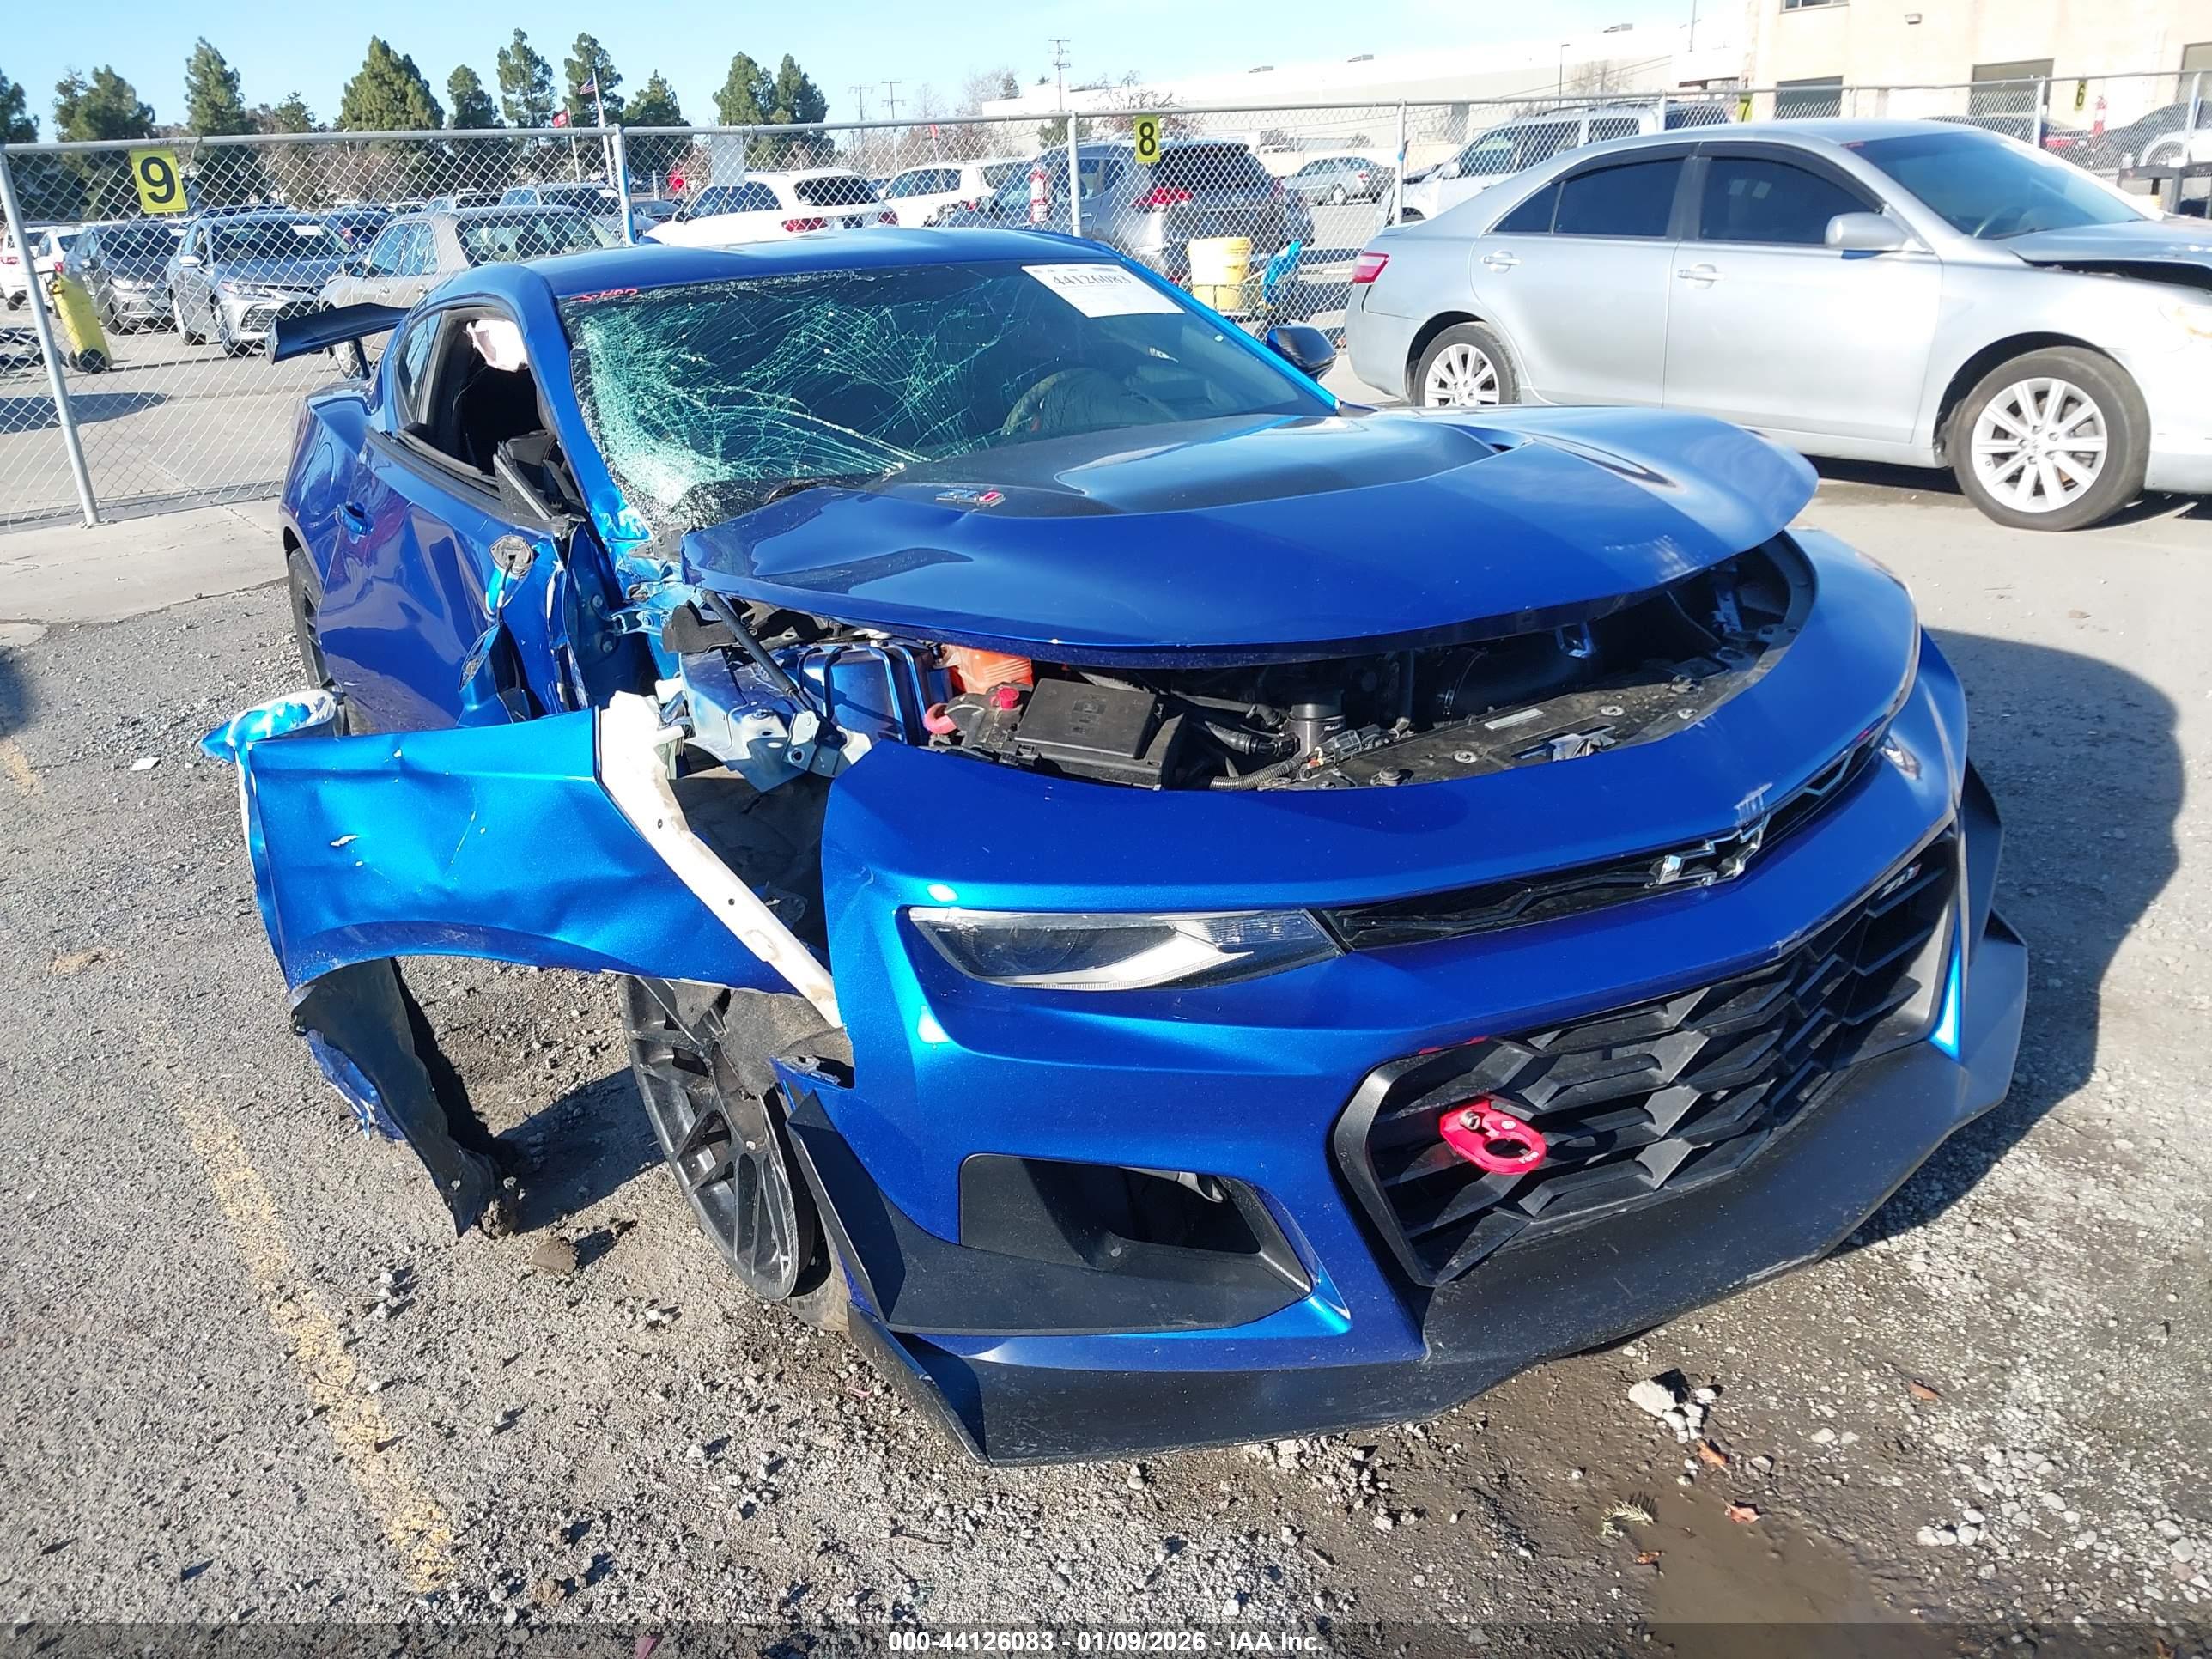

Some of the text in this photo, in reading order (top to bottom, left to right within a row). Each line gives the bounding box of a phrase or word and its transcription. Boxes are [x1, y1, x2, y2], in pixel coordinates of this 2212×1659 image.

[2076, 85, 2086, 106] 6
[1740, 99, 1750, 122] 7
[1139, 122, 1156, 156] 8
[141, 157, 175, 204] 9
